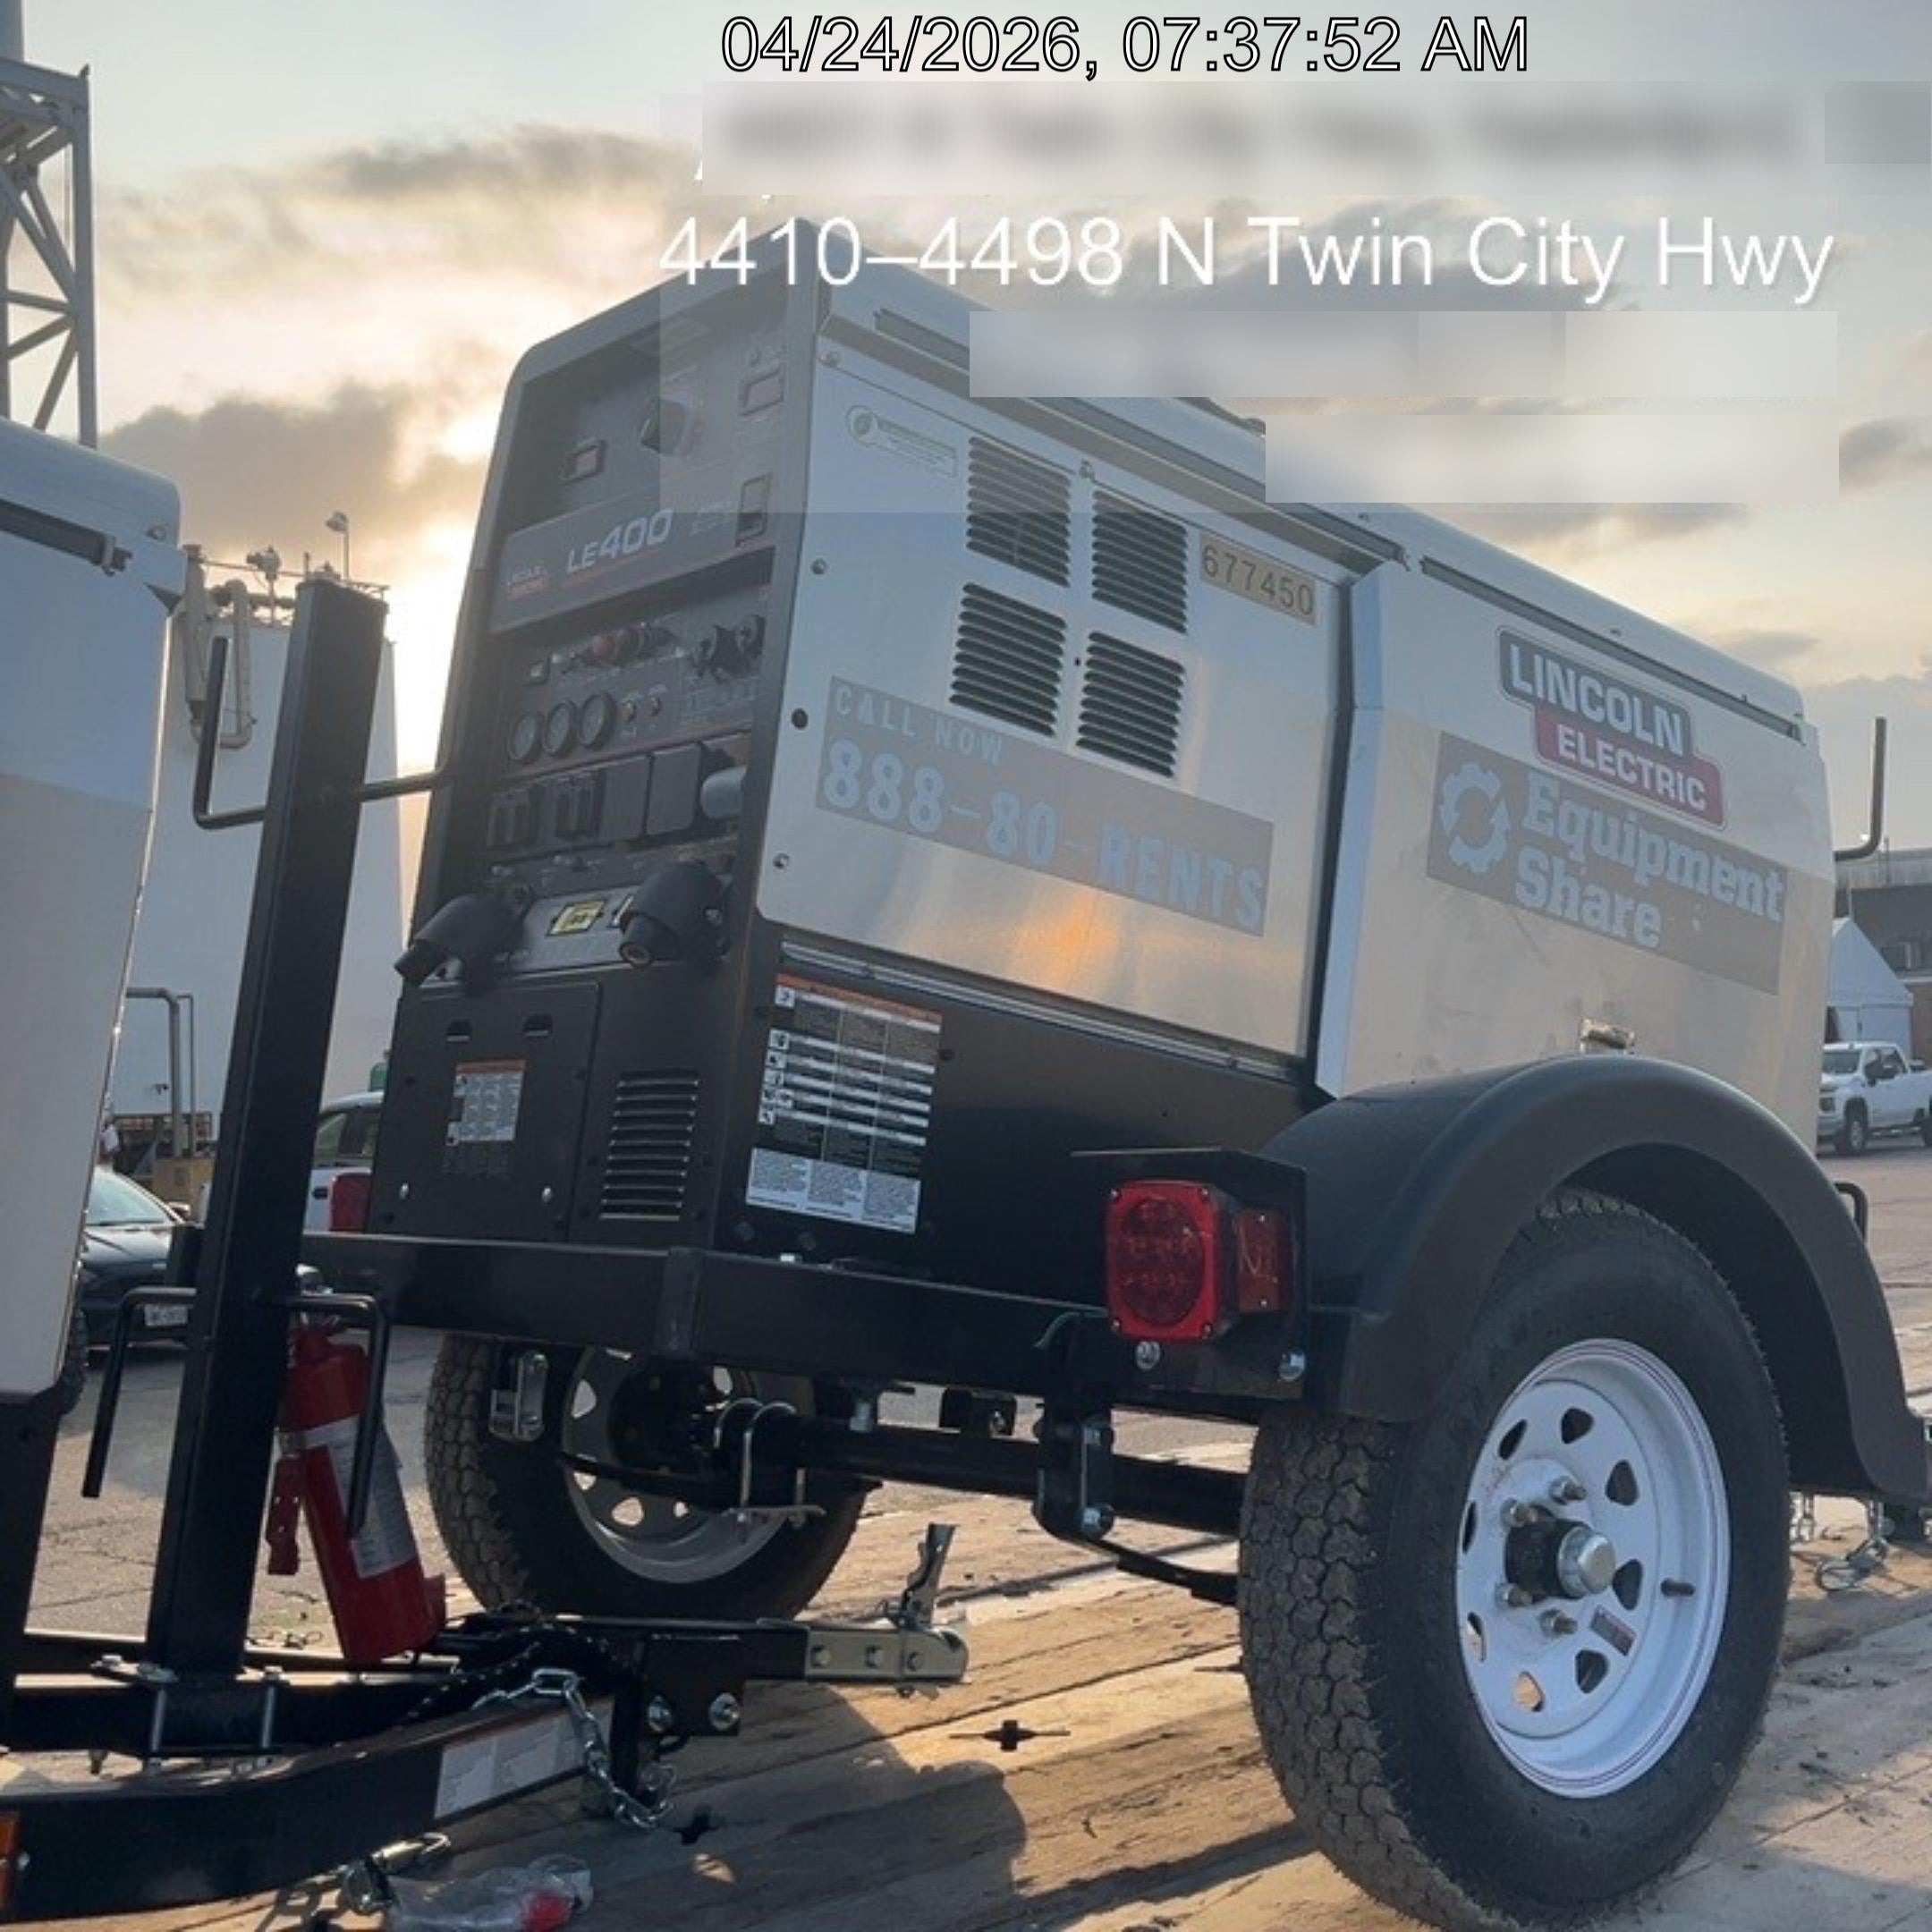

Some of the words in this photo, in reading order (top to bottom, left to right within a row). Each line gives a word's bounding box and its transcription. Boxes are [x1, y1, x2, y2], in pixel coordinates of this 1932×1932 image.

[566, 507, 674, 574] LE400
[1201, 543, 1314, 616] 677450
[835, 685, 916, 739] CALL
[936, 722, 1005, 767] NOW
[1510, 642, 1684, 758] LINCOLN
[1556, 723, 1707, 813] ELECTRIC
[1522, 770, 1785, 924] Equipment
[1514, 845, 1662, 949] Share
